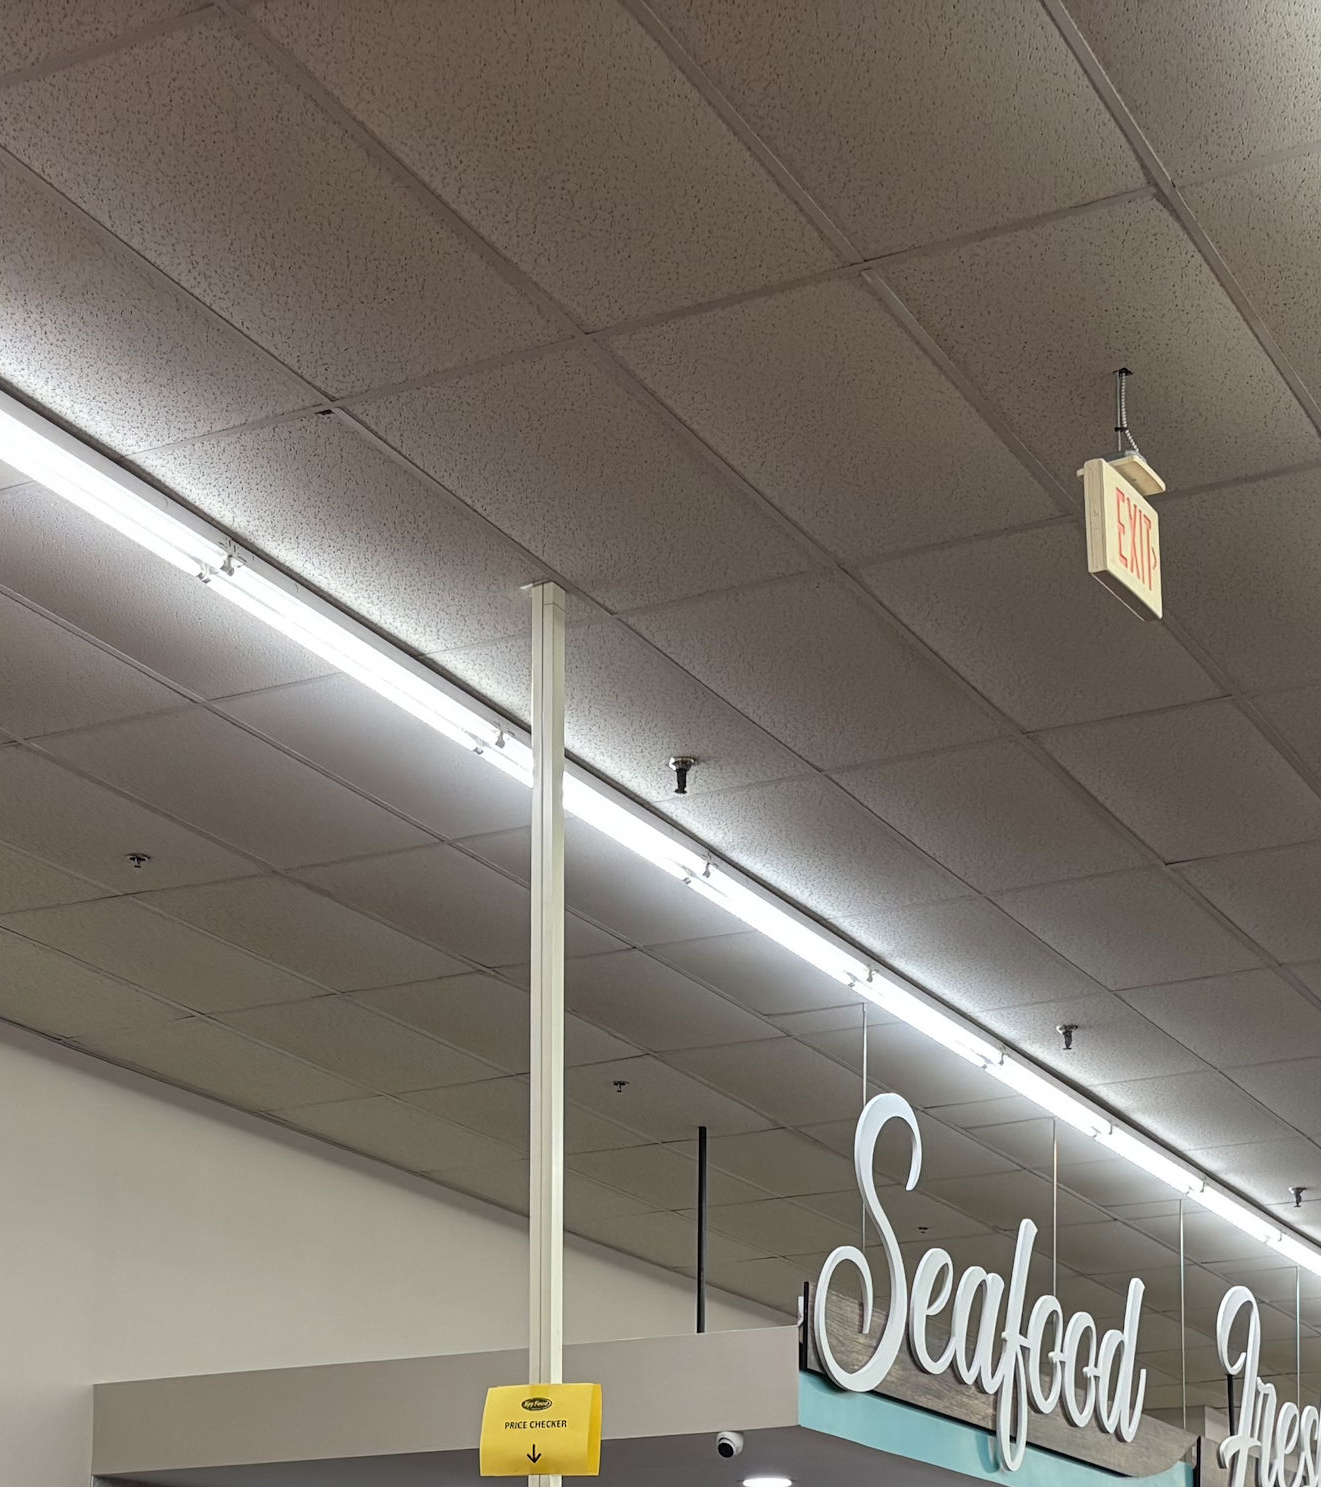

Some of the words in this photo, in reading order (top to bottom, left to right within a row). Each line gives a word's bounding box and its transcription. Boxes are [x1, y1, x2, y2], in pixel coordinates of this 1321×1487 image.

[1116, 487, 1152, 592] EXIT
[814, 1092, 1147, 1472] Seafood
[505, 1420, 527, 1429] PRICE
[529, 1419, 567, 1429] CHECKER
